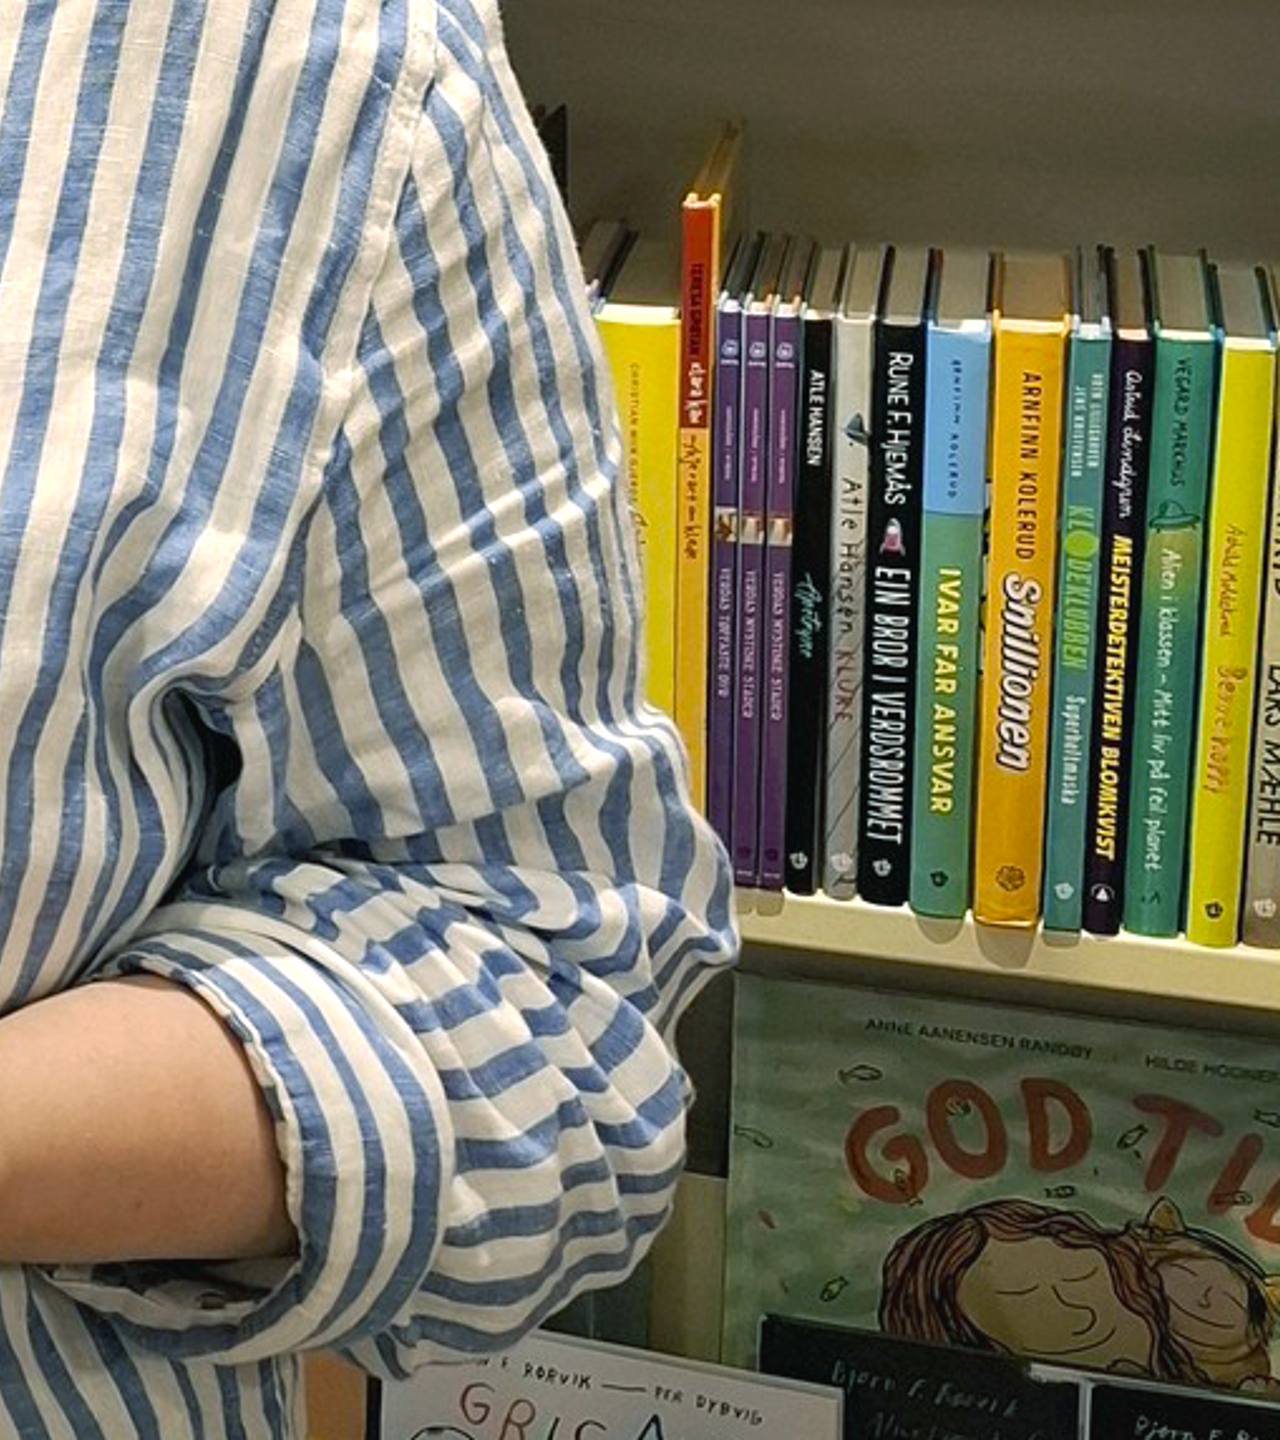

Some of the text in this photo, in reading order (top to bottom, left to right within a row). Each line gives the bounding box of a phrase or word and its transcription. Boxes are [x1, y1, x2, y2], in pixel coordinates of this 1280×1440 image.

[806, 369, 826, 467] ATLE HANSEN
[1169, 356, 1192, 488] VEGARD MARKHUS
[1016, 370, 1044, 561] ARNFINN KOLERUD
[874, 565, 911, 607] EIN
[1159, 548, 1181, 590] Alien
[871, 611, 910, 671] BROR
[1155, 606, 1179, 668] klassen
[929, 567, 963, 815] IVAR FÅR ANSVAR
[993, 571, 1043, 773] Snillionen
[1092, 533, 1134, 862] MEISTERDETEKTIVEN BLOMKVIST
[1151, 689, 1174, 727] Mitt
[865, 689, 907, 846] VERDSROMMET
[1060, 694, 1087, 805] Superheltmaska
[1146, 758, 1170, 780] på
[1150, 734, 1171, 754] liv
[1148, 785, 1169, 813] feil
[1142, 818, 1168, 871] planet
[865, 1018, 914, 1037] ANNE
[918, 1024, 1016, 1050] AANENSEN
[844, 1076, 1094, 1205] GOD
[523, 1361, 593, 1390] RØRVIK
[695, 1393, 764, 1426] DYBVIG
